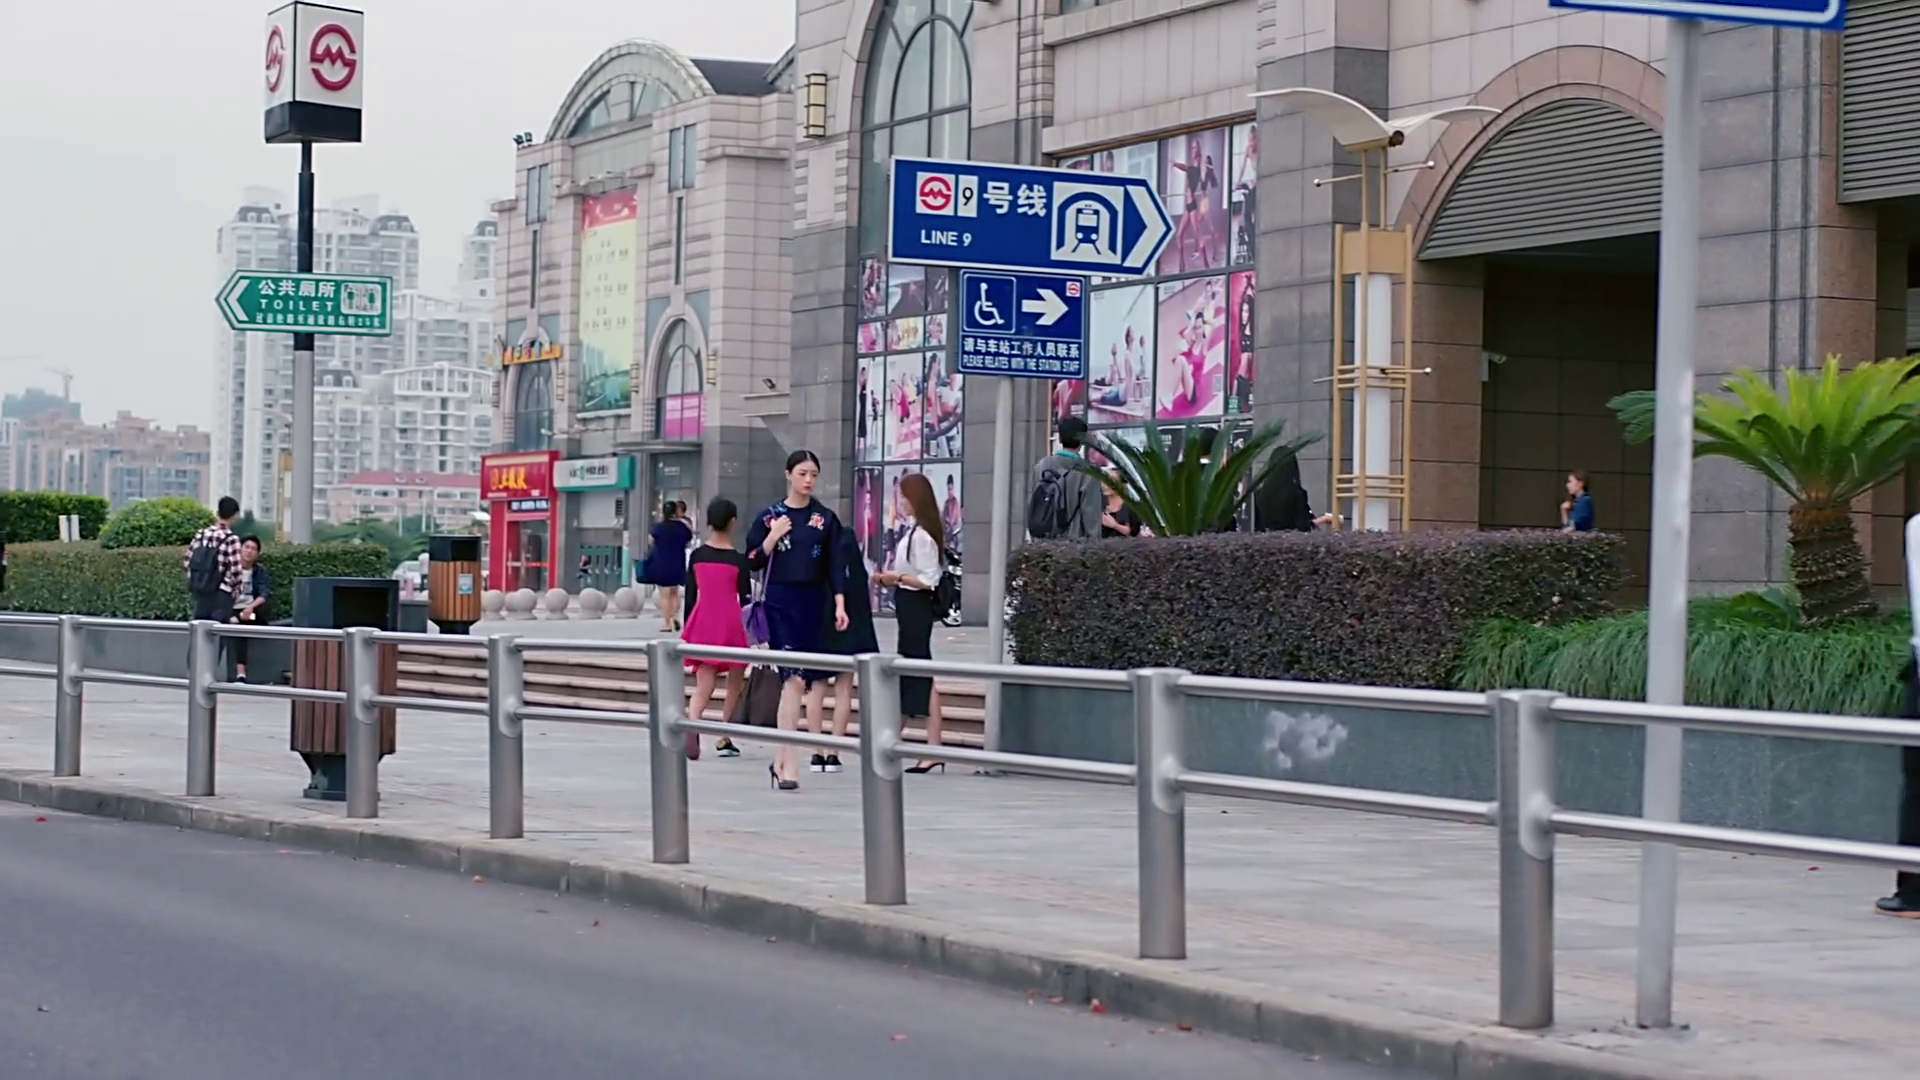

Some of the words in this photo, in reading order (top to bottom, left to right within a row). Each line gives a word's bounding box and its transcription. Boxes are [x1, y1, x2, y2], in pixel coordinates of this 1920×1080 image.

[920, 229, 959, 246] LINE
[962, 232, 973, 247] 9
[258, 279, 336, 298] 公共厕所
[259, 299, 334, 312] TOILET
[963, 337, 1081, 358] 请与车站工作人员联系
[963, 355, 984, 368] PLEASE
[985, 356, 1009, 369] RELATES
[1011, 357, 1025, 370] WITH
[1026, 358, 1037, 371] THE
[1038, 359, 1062, 372] STATION
[1062, 360, 1081, 373] STAFF
